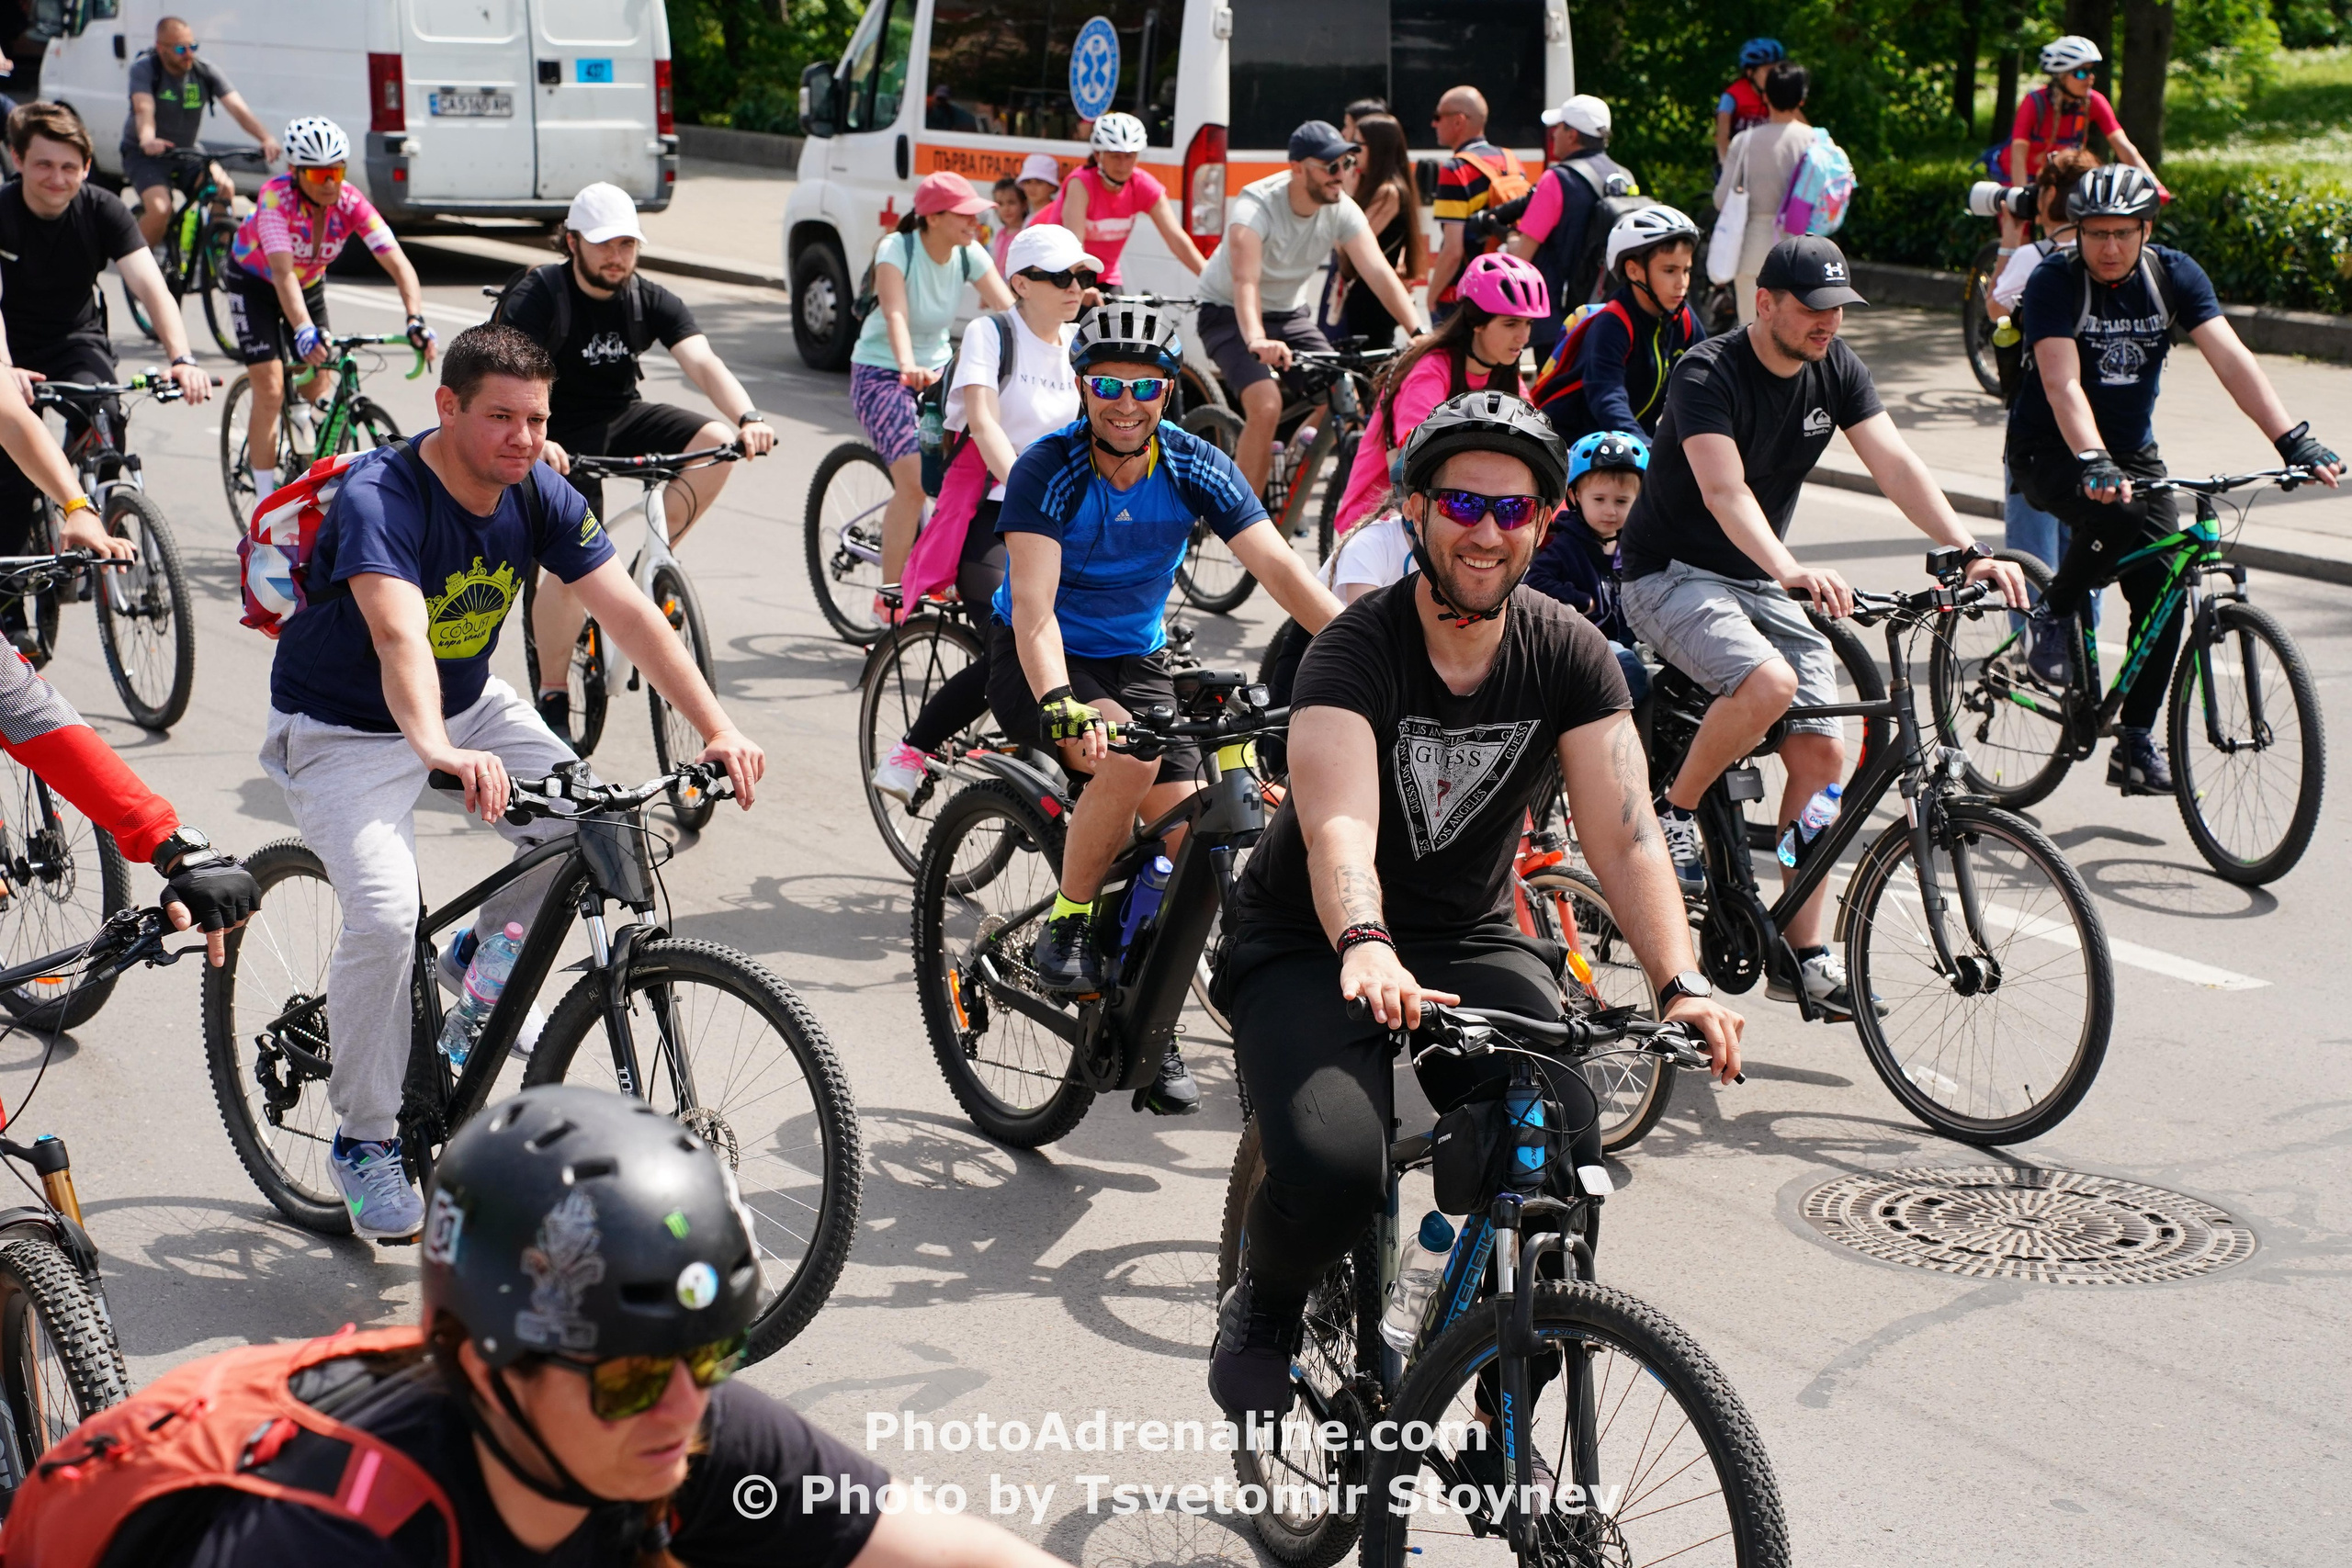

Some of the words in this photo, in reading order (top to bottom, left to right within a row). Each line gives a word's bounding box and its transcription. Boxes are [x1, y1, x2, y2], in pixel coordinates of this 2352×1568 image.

[933, 150, 976, 173] ПЪРВА
[979, 154, 1022, 176] ГРАДС
[1430, 727, 1467, 746] ANELES
[1505, 725, 1528, 760] GUESS
[1416, 745, 1481, 770] GUESS
[1406, 784, 1420, 814] GUESS
[1449, 788, 1487, 828] ANGELES
[617, 1066, 633, 1091] 100
[1448, 1218, 1498, 1323] TERBIK
[1503, 1392, 1519, 1508] INTERBIKE
